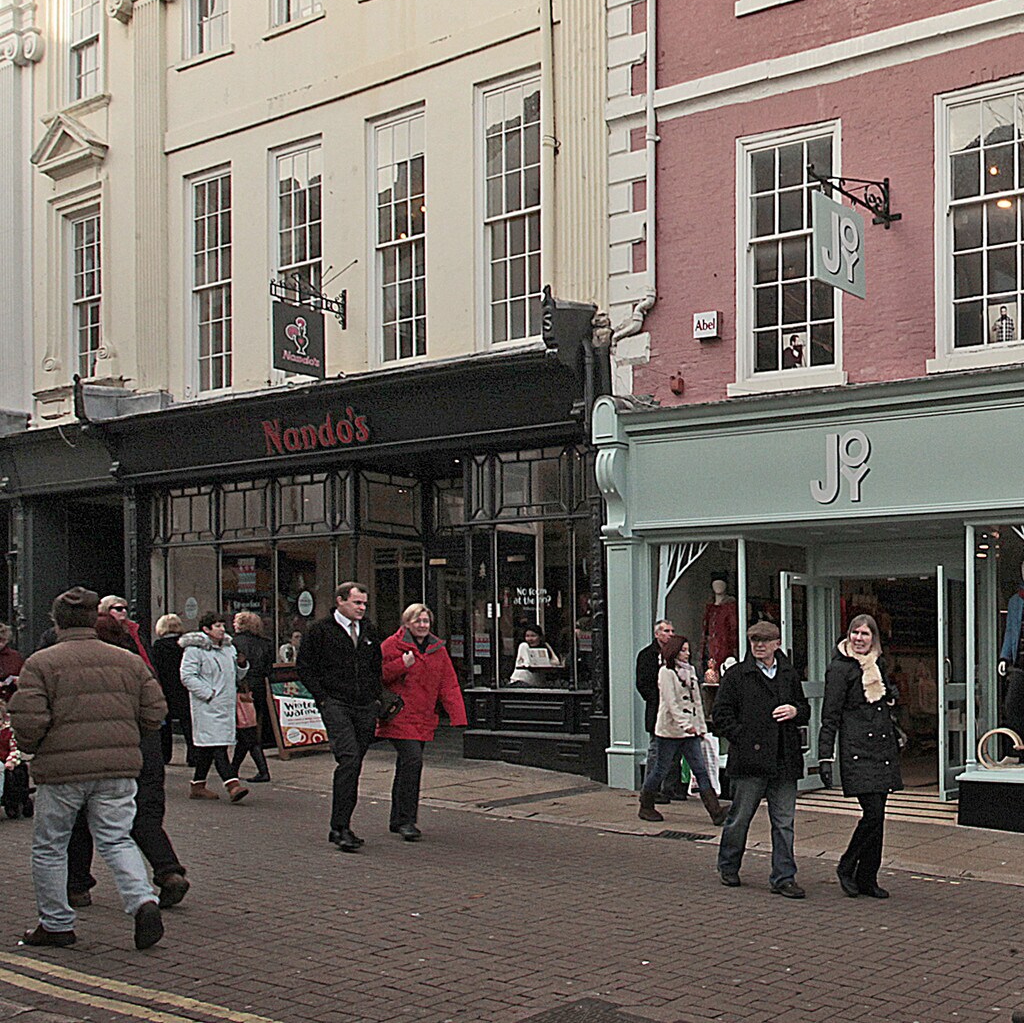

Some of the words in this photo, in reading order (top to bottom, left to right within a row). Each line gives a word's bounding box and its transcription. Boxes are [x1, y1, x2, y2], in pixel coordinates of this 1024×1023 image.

[821, 211, 860, 284] JOY
[695, 317, 715, 331] Abel
[282, 350, 320, 367] Nando's
[261, 405, 370, 456] Nando's
[809, 429, 872, 505] JOY
[516, 587, 527, 596] No
[513, 596, 522, 605] at
